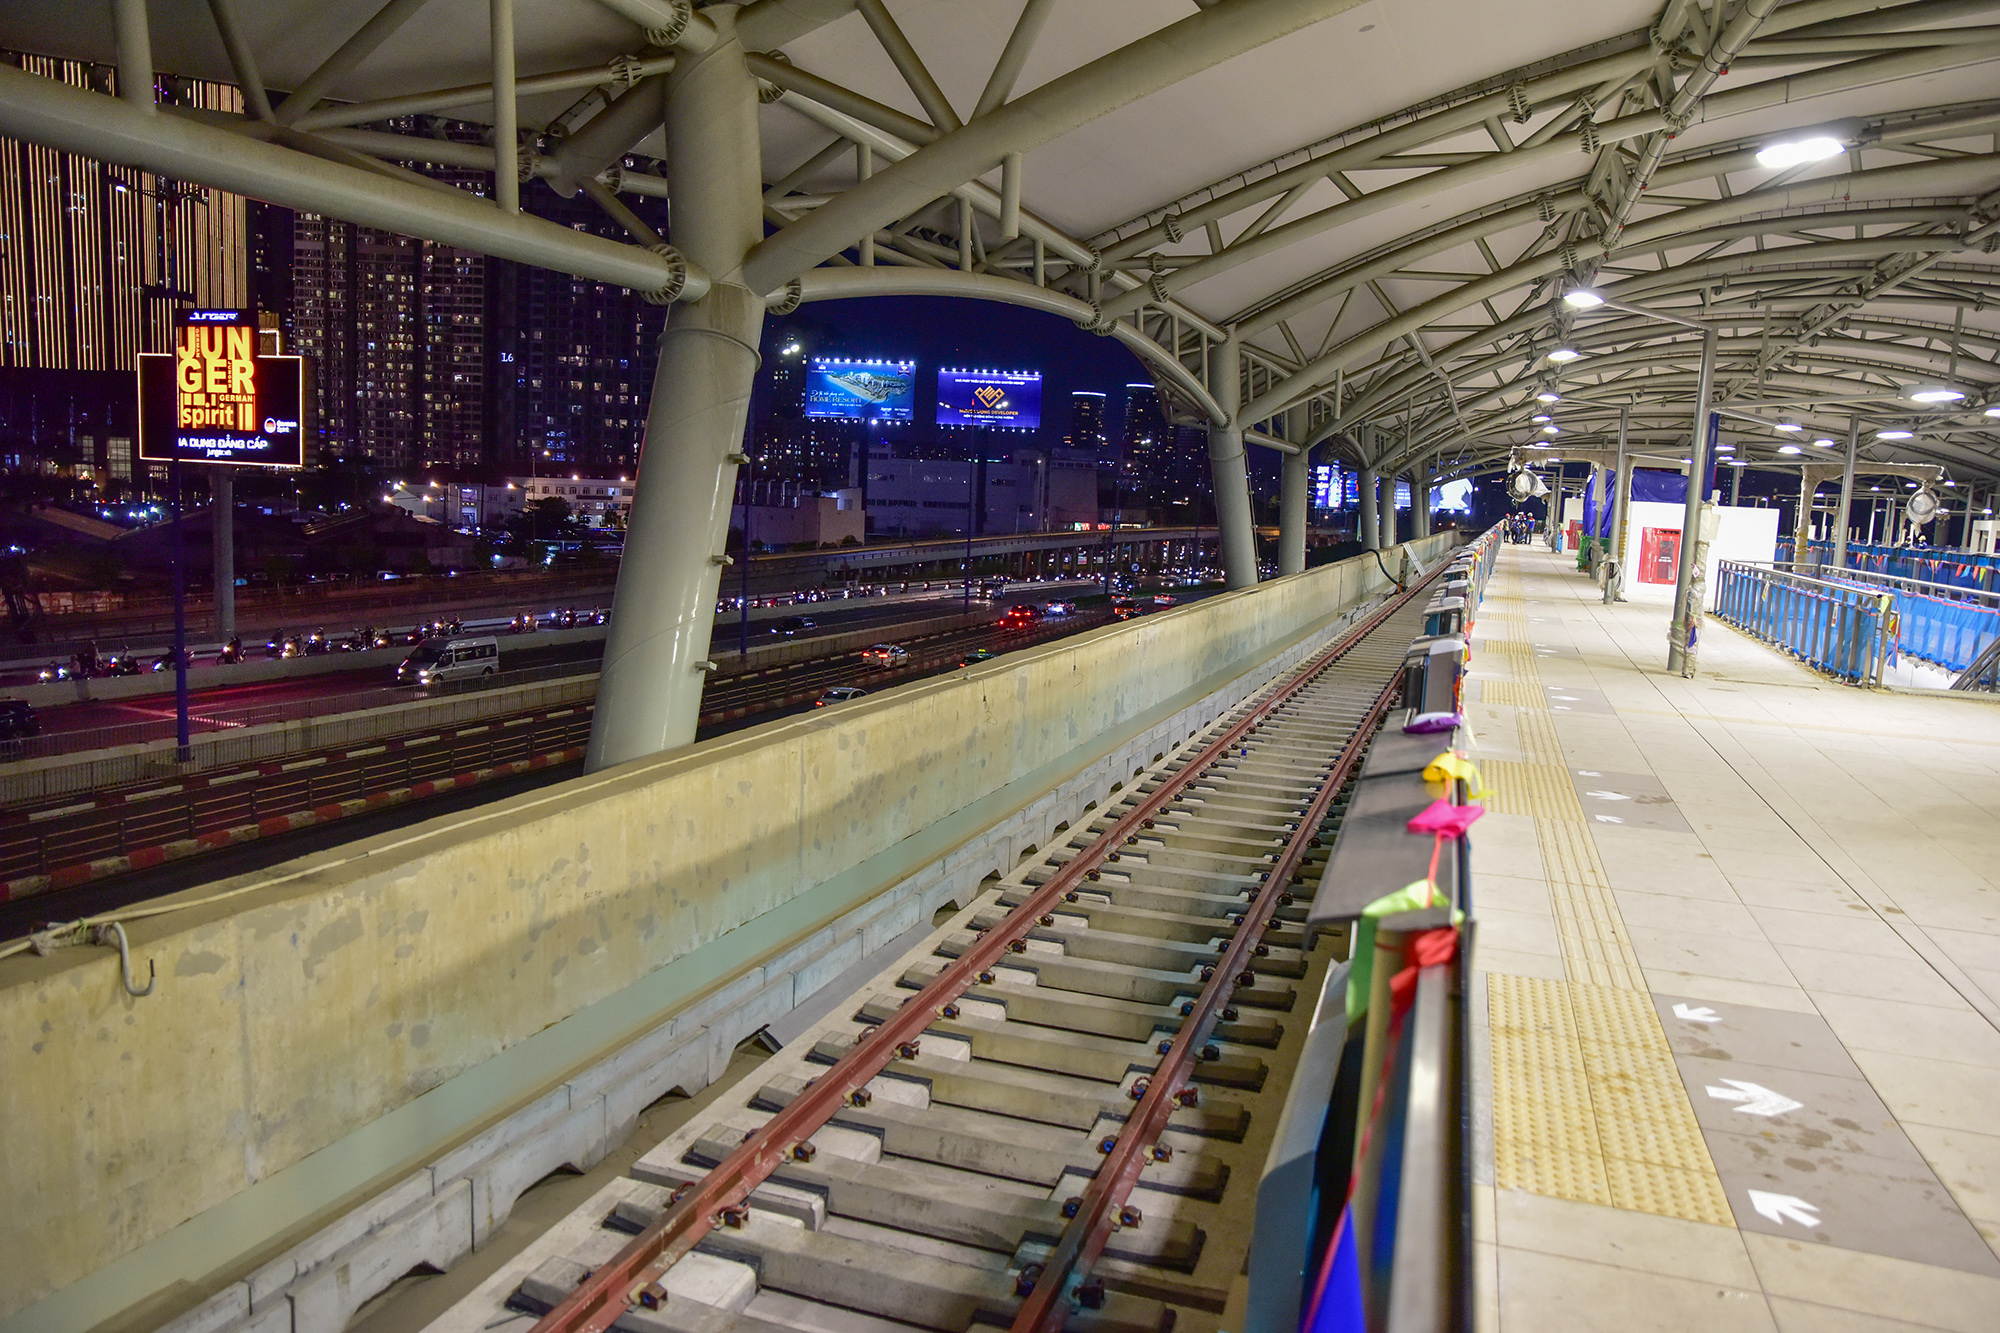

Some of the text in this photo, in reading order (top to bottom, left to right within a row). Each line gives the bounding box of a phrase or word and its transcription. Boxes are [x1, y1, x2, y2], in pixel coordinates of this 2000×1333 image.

[178, 326, 250, 359] JUN
[178, 359, 255, 393] GER
[219, 394, 253, 402] GERMAN
[182, 402, 234, 428] spirit
[246, 435, 268, 449] CẤP
